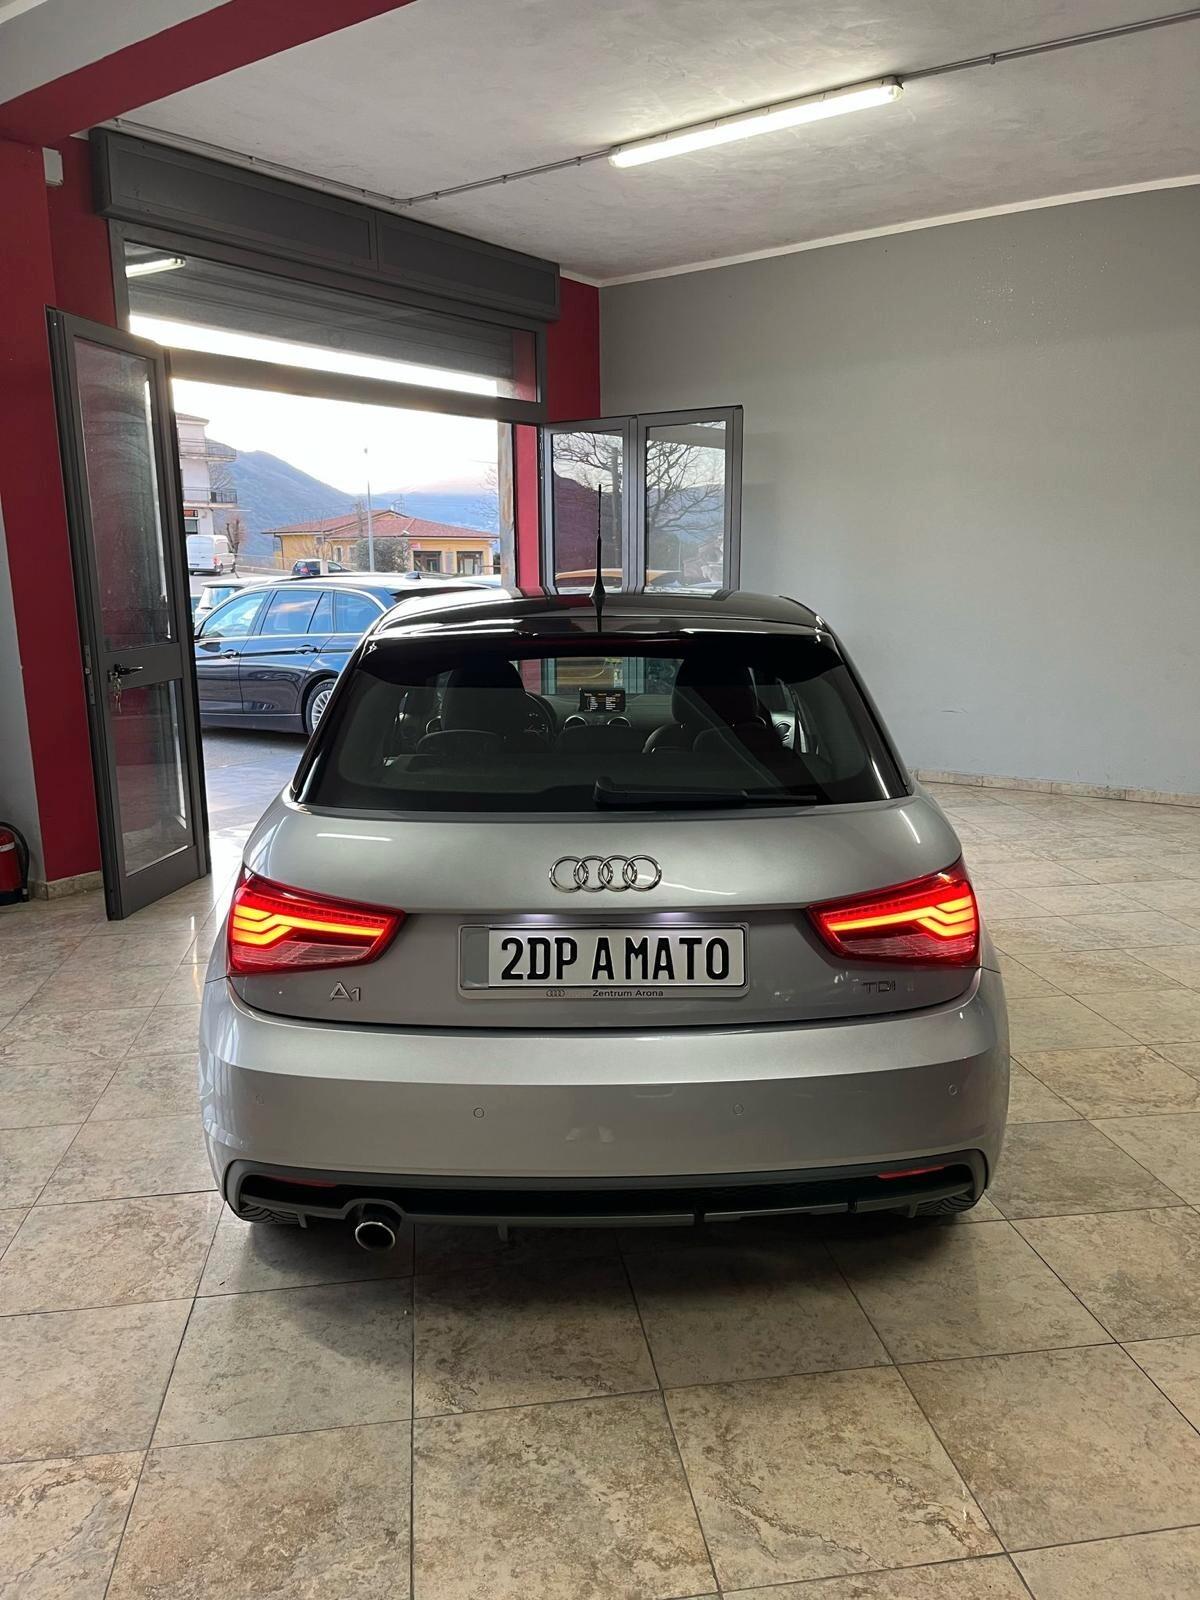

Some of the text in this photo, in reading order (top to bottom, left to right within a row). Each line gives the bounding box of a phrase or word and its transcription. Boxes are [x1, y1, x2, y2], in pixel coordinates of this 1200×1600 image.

[501, 937, 578, 980] 2DP
[329, 981, 361, 1002] A1
[592, 989, 664, 998] Zentrum Arona
[862, 980, 896, 993] TDI
